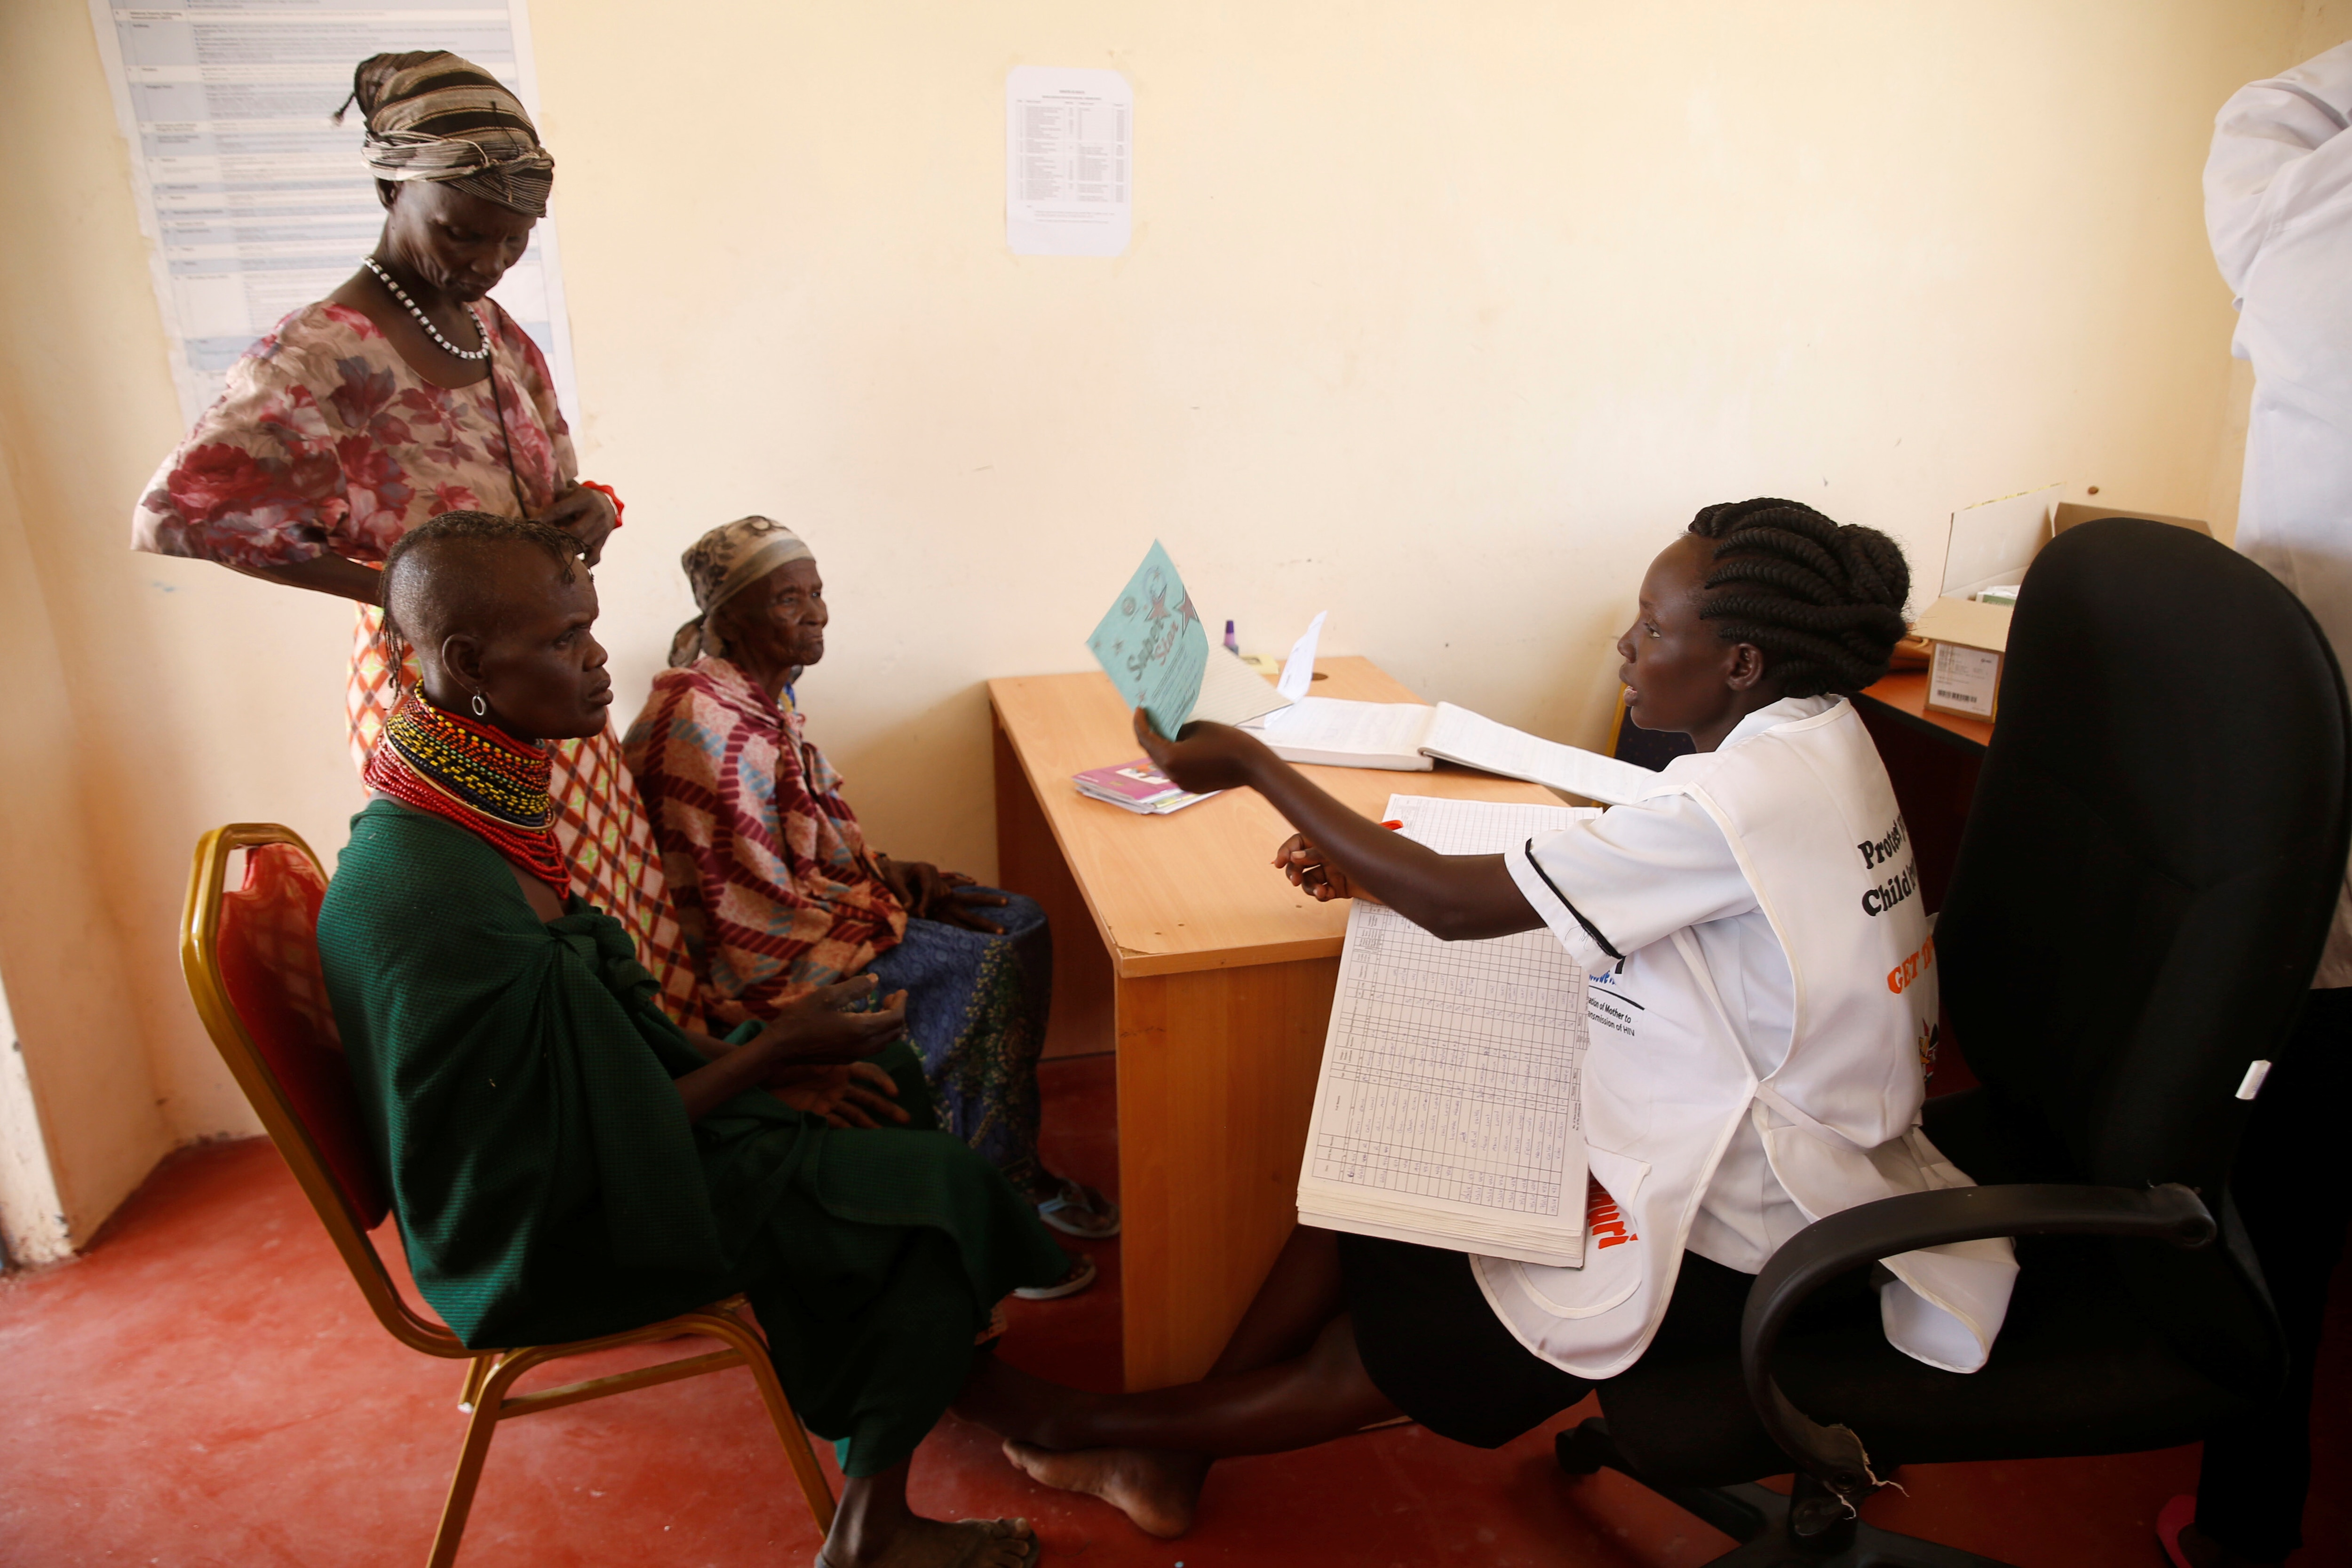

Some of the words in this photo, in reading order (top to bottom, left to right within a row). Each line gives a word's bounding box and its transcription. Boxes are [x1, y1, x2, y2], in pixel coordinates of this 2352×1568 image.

[1858, 819, 1902, 869] Protect
[1862, 869, 1912, 916] Child
[1887, 951, 1919, 994] GET
[1605, 1004, 1624, 1020] Mother
[1624, 1014, 1631, 1024] to
[1623, 1025, 1635, 1036] HIV
